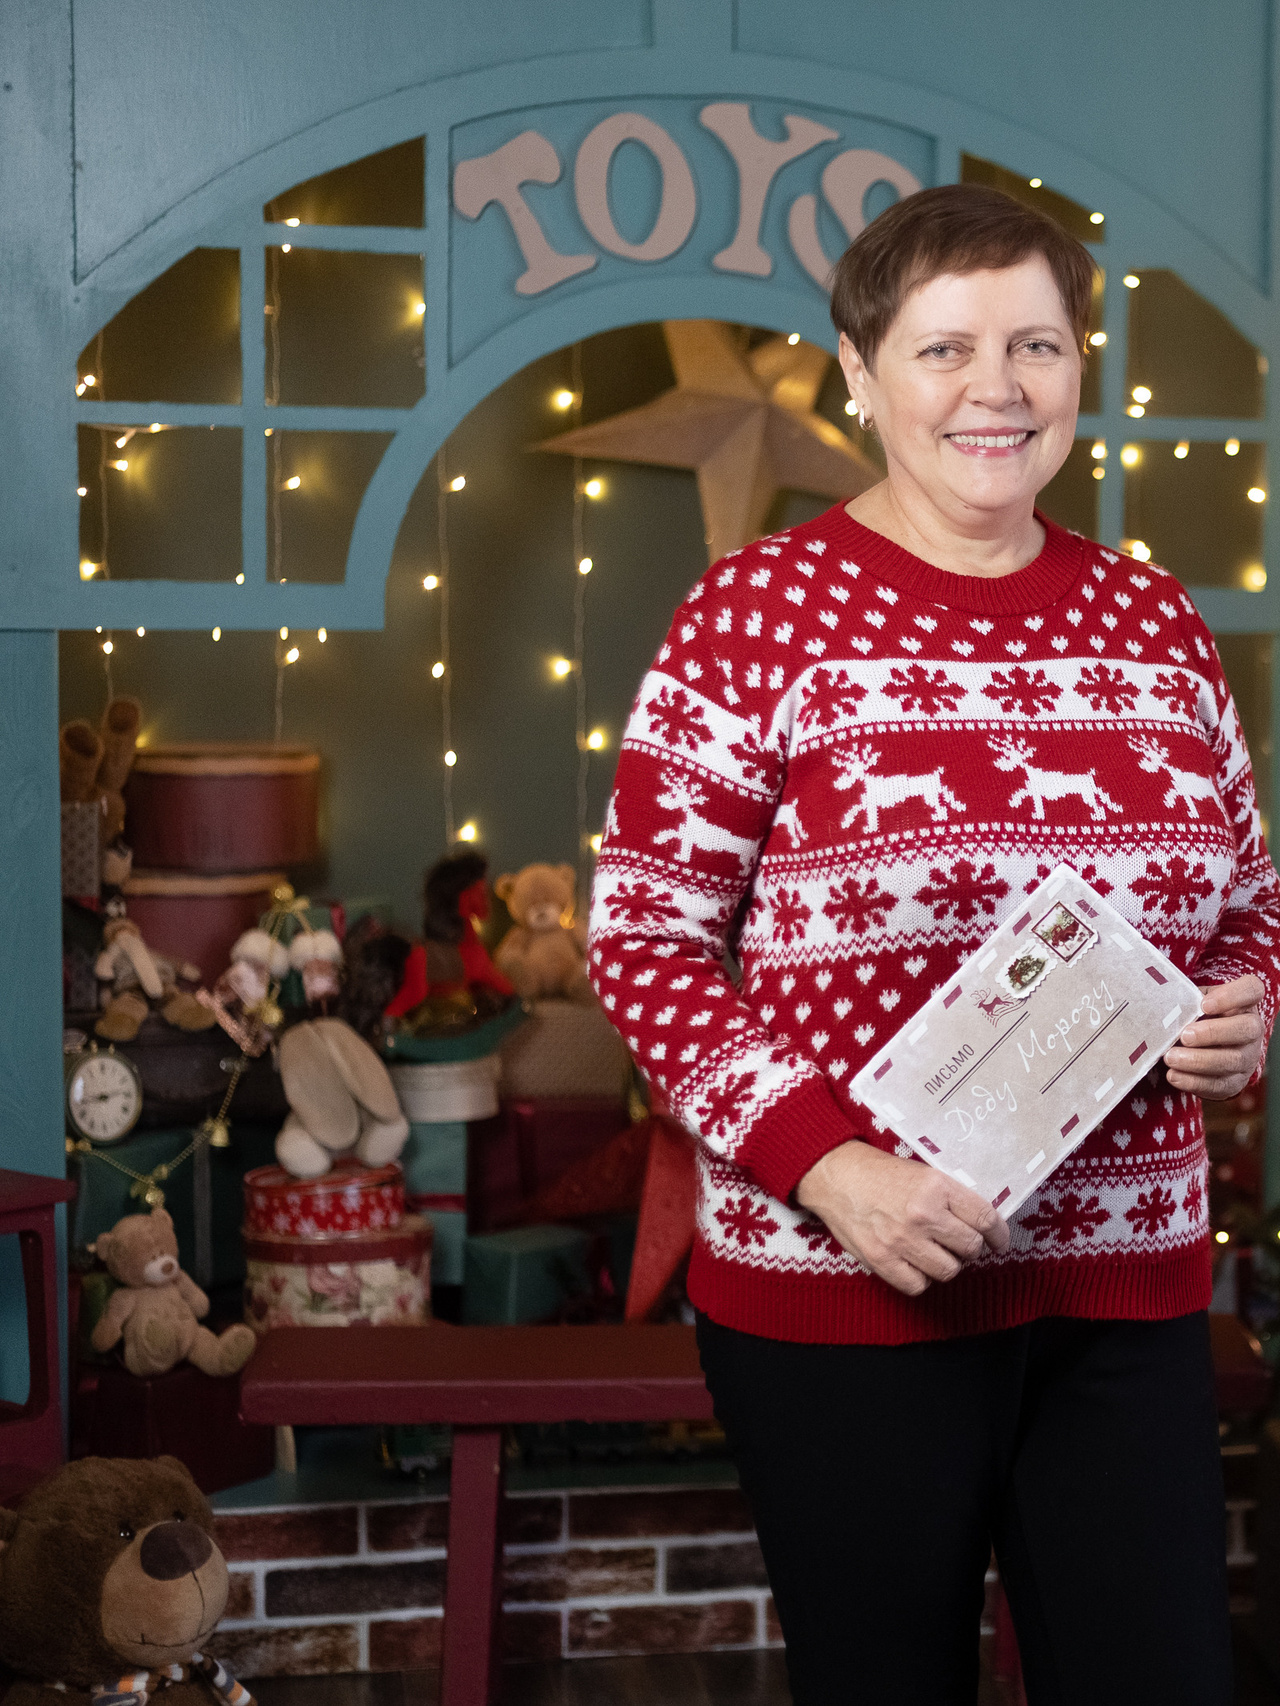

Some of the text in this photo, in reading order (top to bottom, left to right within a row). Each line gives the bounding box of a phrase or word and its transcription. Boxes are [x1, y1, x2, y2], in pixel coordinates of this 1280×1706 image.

[924, 1043, 976, 1095] ПИСЬМО
[944, 979, 1116, 1143] Деду Морозу
